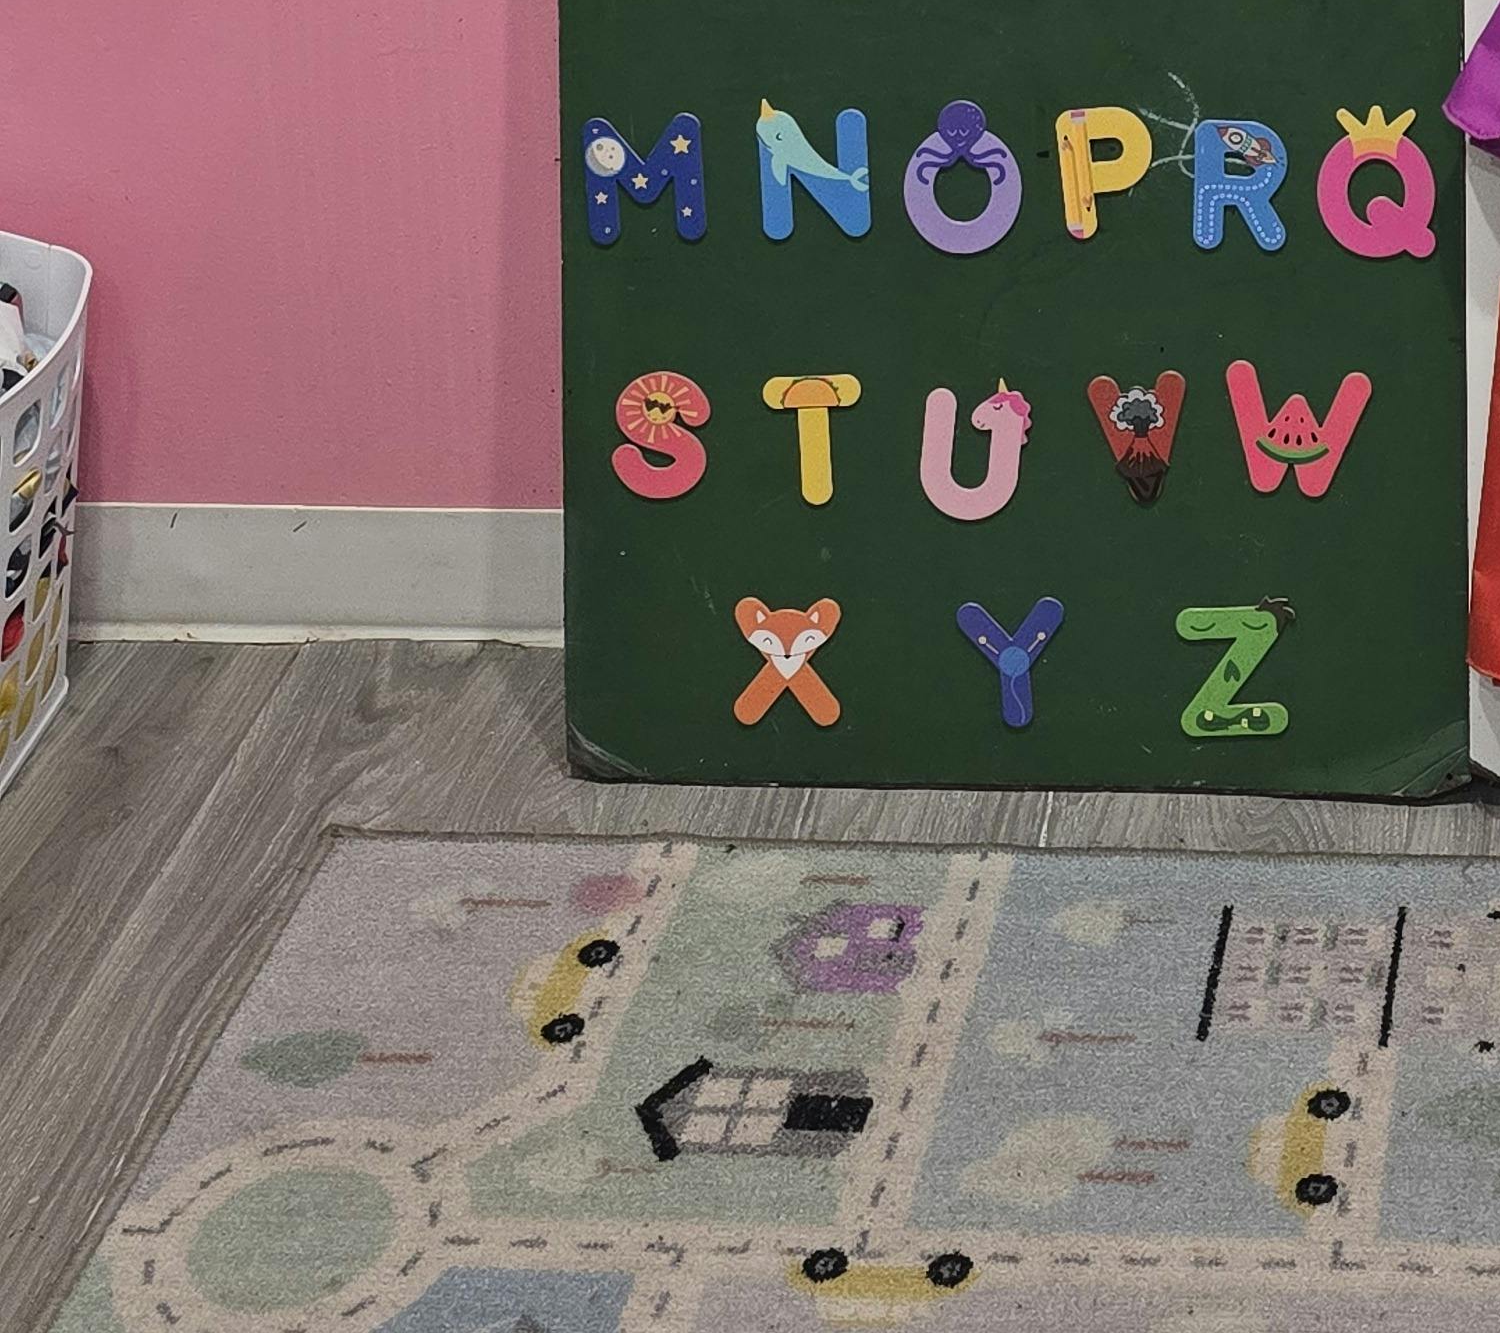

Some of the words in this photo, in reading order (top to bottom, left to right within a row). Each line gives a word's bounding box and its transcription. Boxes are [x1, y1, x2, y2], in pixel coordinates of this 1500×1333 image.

[582, 110, 708, 246] M
[755, 98, 871, 241] N
[902, 100, 1023, 255] O
[1054, 105, 1154, 240] P
[1191, 118, 1290, 252] R
[1316, 104, 1436, 259] Q
[611, 369, 712, 500] S
[761, 372, 863, 507] T
[919, 377, 1034, 522] U
[1086, 369, 1188, 504] V
[1224, 359, 1373, 498] W
[732, 596, 842, 728] X
[955, 595, 1066, 728] Y
[1175, 595, 1296, 738] Z
